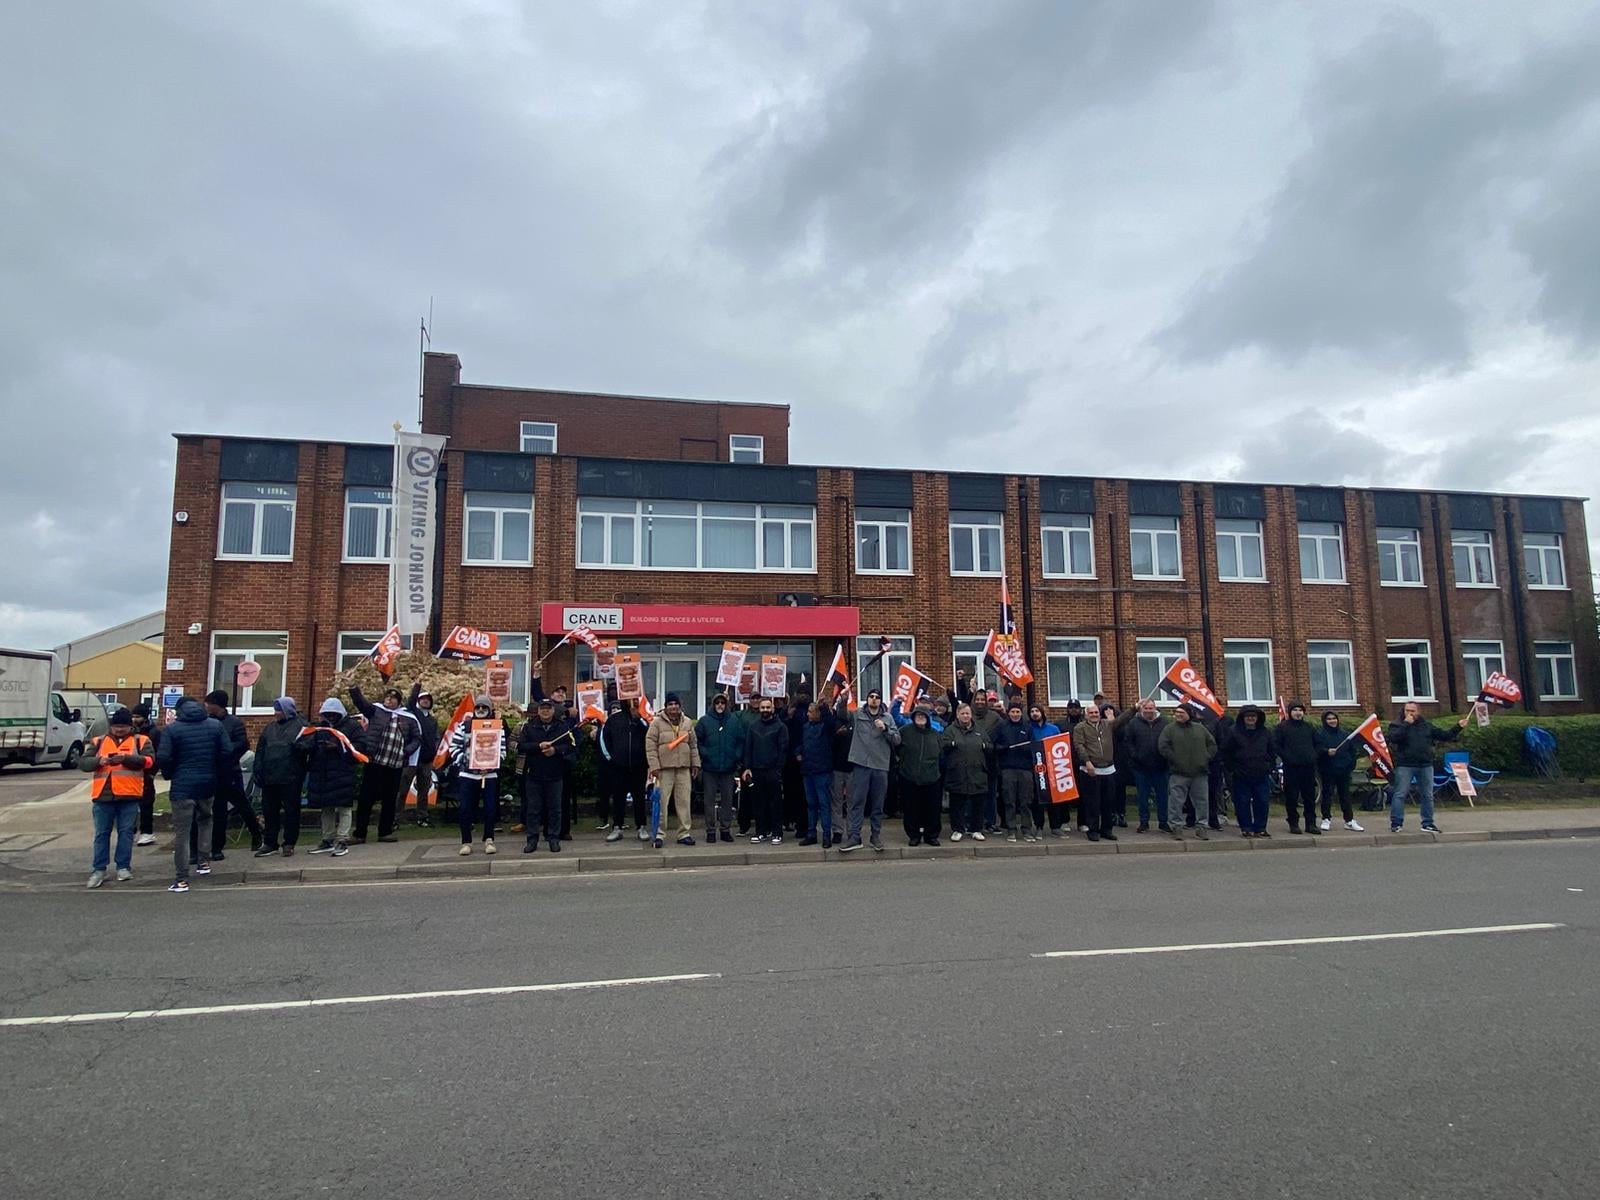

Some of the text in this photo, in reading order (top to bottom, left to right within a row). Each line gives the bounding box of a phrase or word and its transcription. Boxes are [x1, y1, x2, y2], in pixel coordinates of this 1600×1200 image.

[409, 480, 430, 614] VIKING JOHNSON
[568, 613, 618, 625] CRANE
[455, 627, 490, 649] GMB
[1486, 670, 1520, 696] GMB
[1051, 741, 1074, 793] GMB
